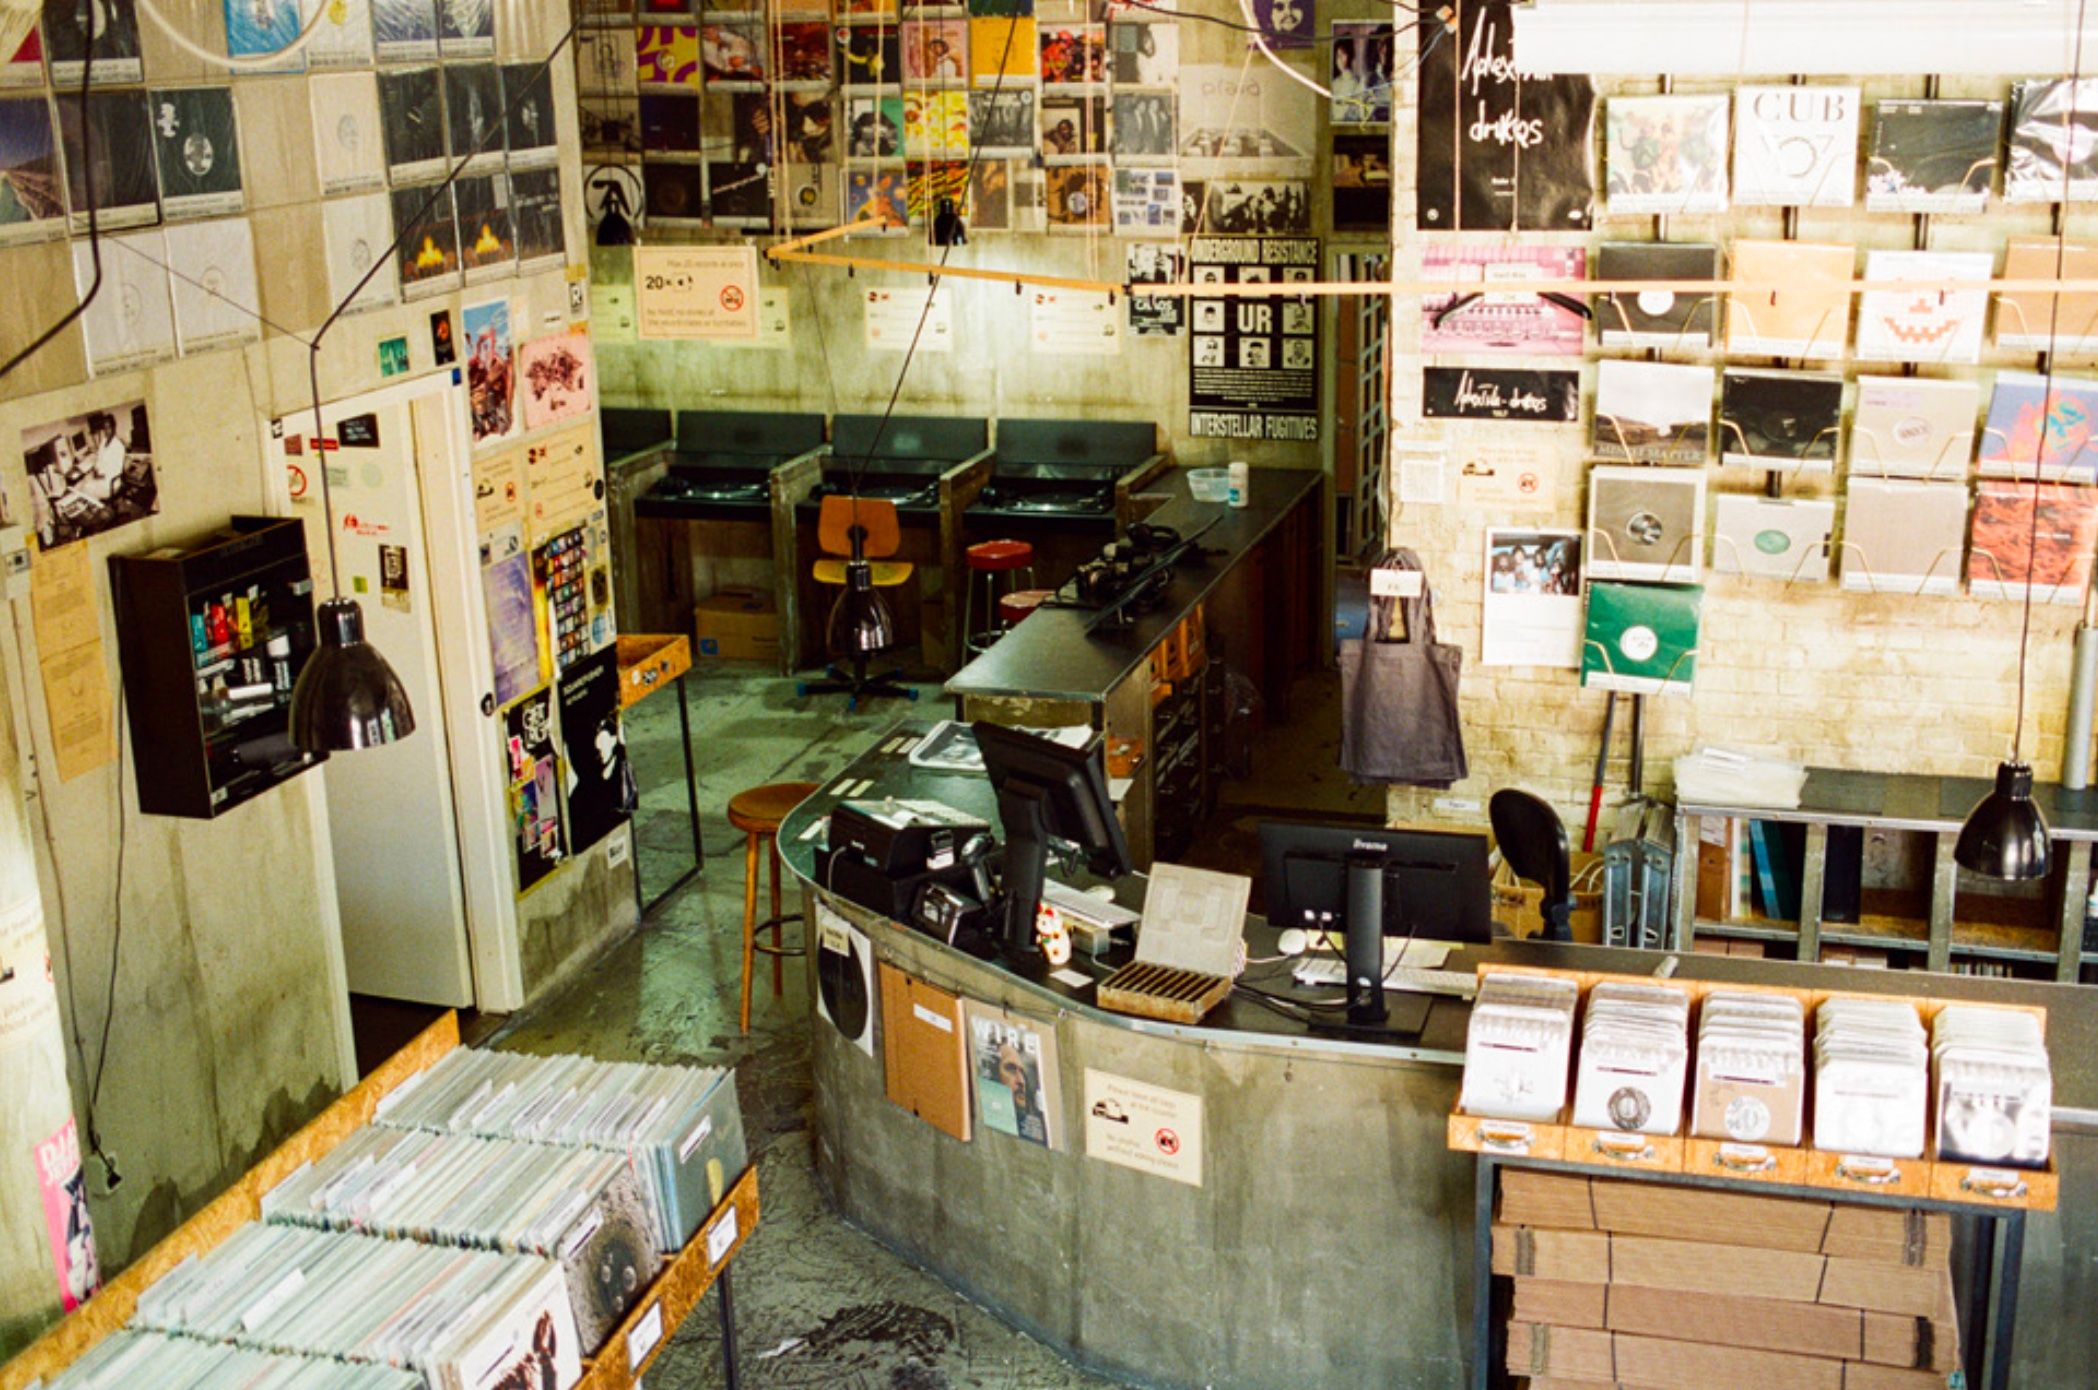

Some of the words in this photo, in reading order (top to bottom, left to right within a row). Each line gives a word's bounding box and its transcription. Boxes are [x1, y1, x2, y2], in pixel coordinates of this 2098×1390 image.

[1753, 91, 1845, 122] CUB
[1237, 303, 1272, 334] UR
[971, 1016, 1040, 1058] WIRE
